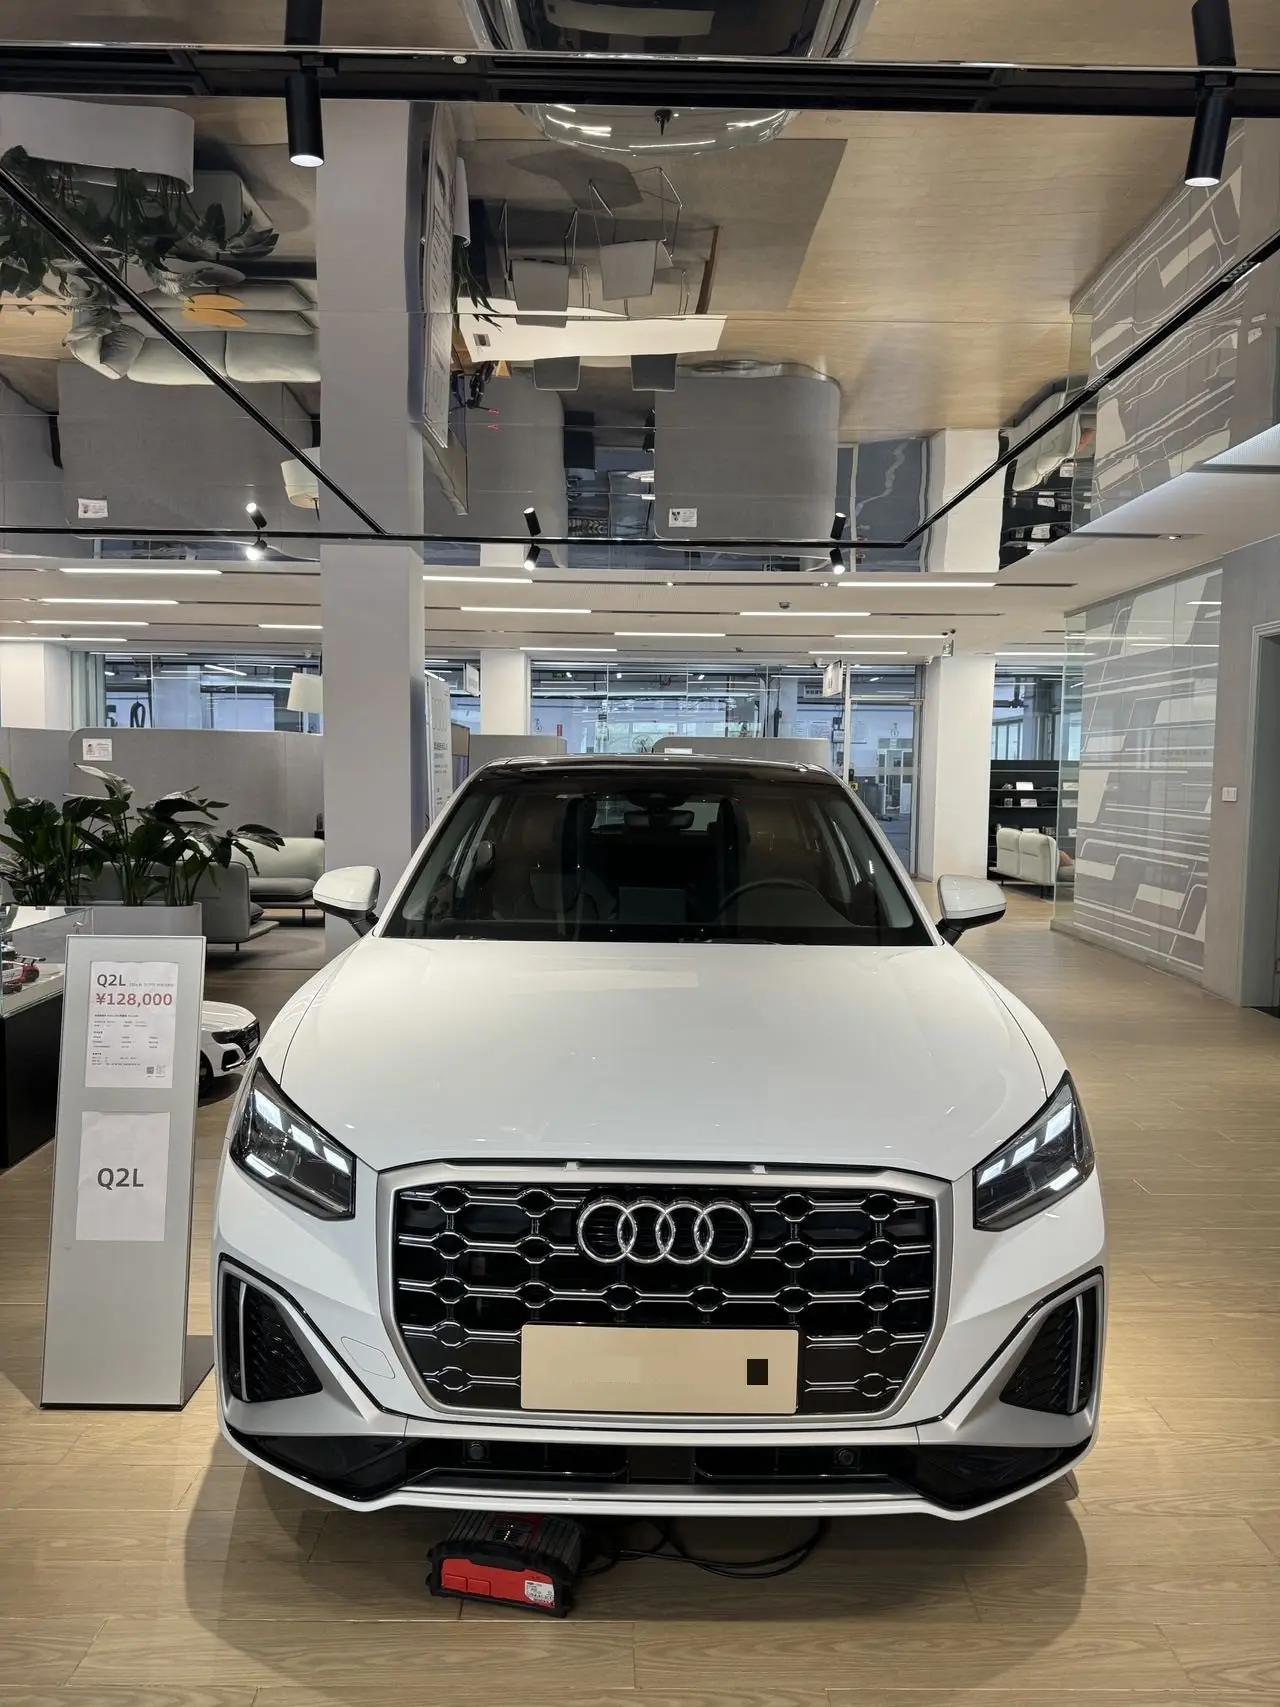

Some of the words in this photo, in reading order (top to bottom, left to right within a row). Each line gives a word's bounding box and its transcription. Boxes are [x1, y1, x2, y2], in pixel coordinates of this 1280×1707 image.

[96, 974, 127, 988] Q2L
[95, 992, 174, 1008] ¥128,000
[97, 1167, 144, 1191] Q2L
